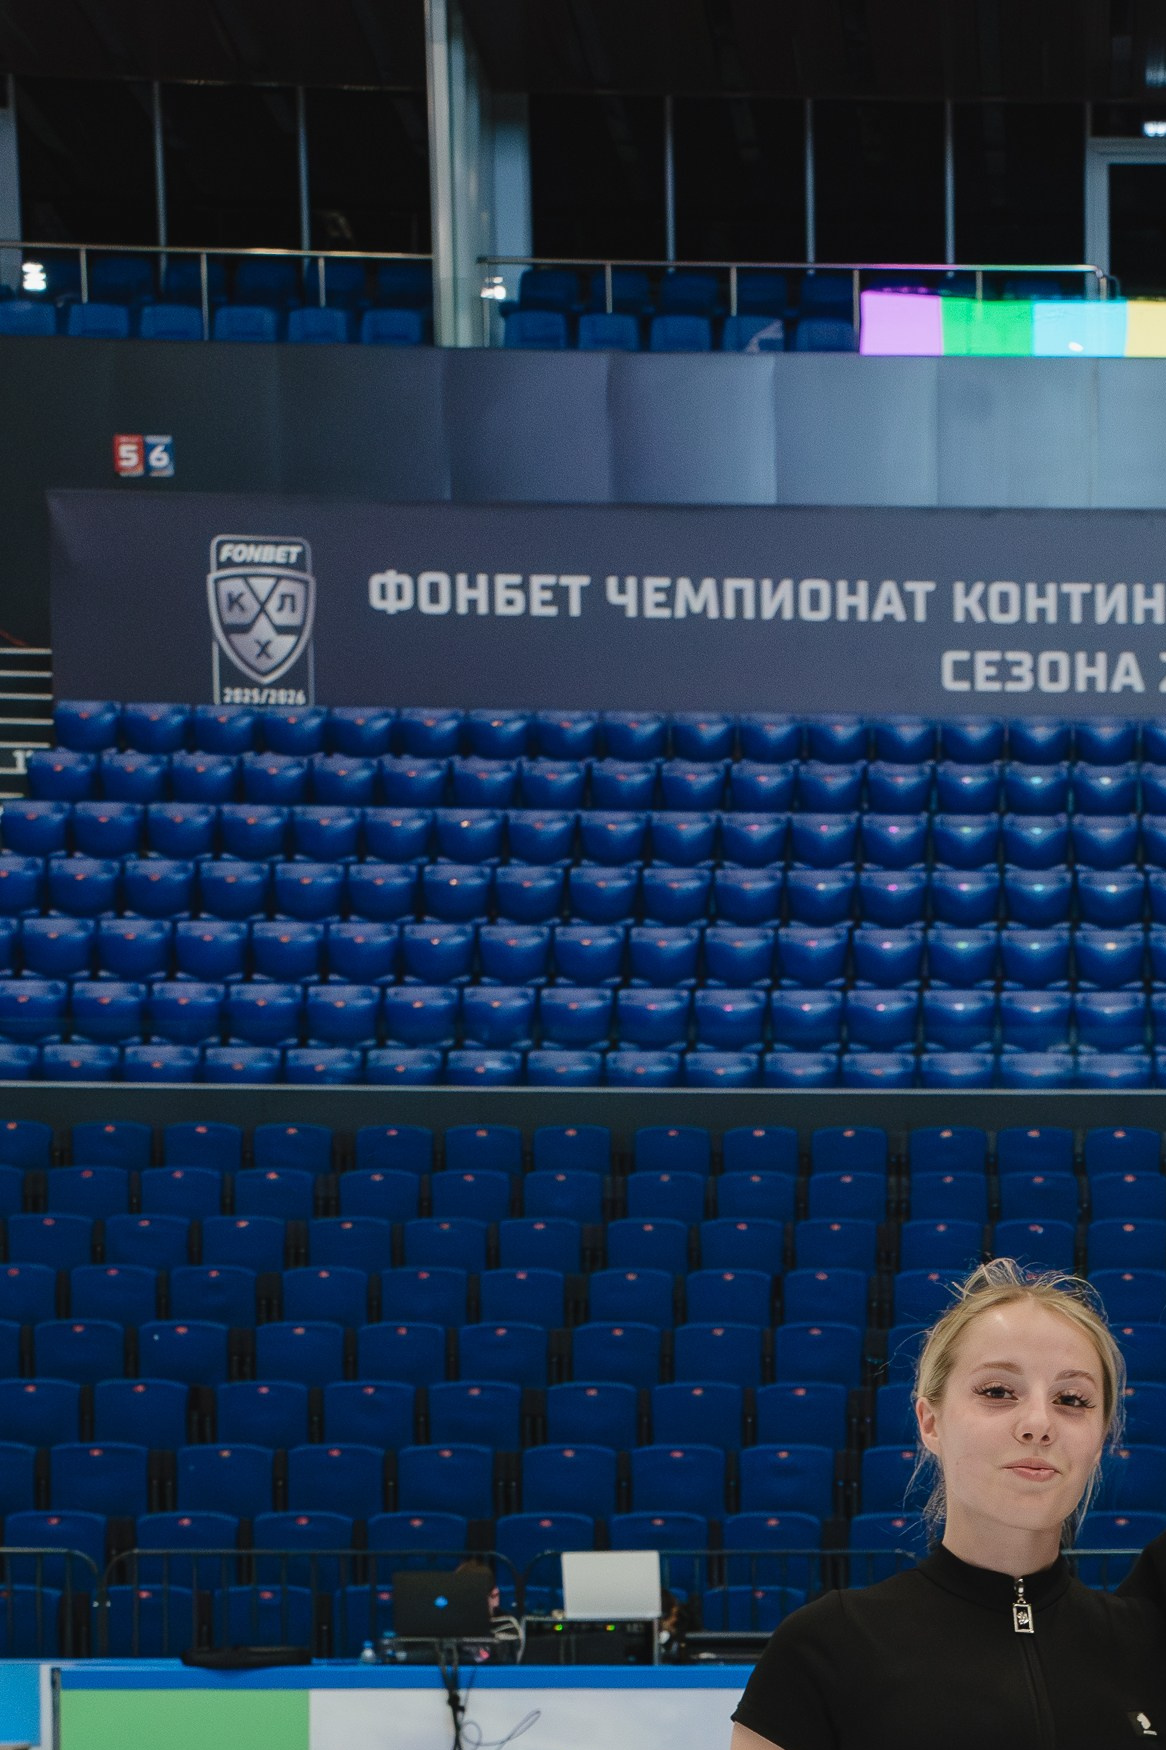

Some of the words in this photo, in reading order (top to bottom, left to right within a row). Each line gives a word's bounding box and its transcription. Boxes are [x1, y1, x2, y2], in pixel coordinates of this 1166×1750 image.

[118, 443, 140, 468] 5
[148, 444, 170, 469] 6
[219, 543, 302, 564] FONBET
[369, 569, 591, 617] ФОНБЕТ
[606, 575, 936, 623] ЧЕМПИОНАТ
[941, 650, 1145, 693] СЕЗОНА
